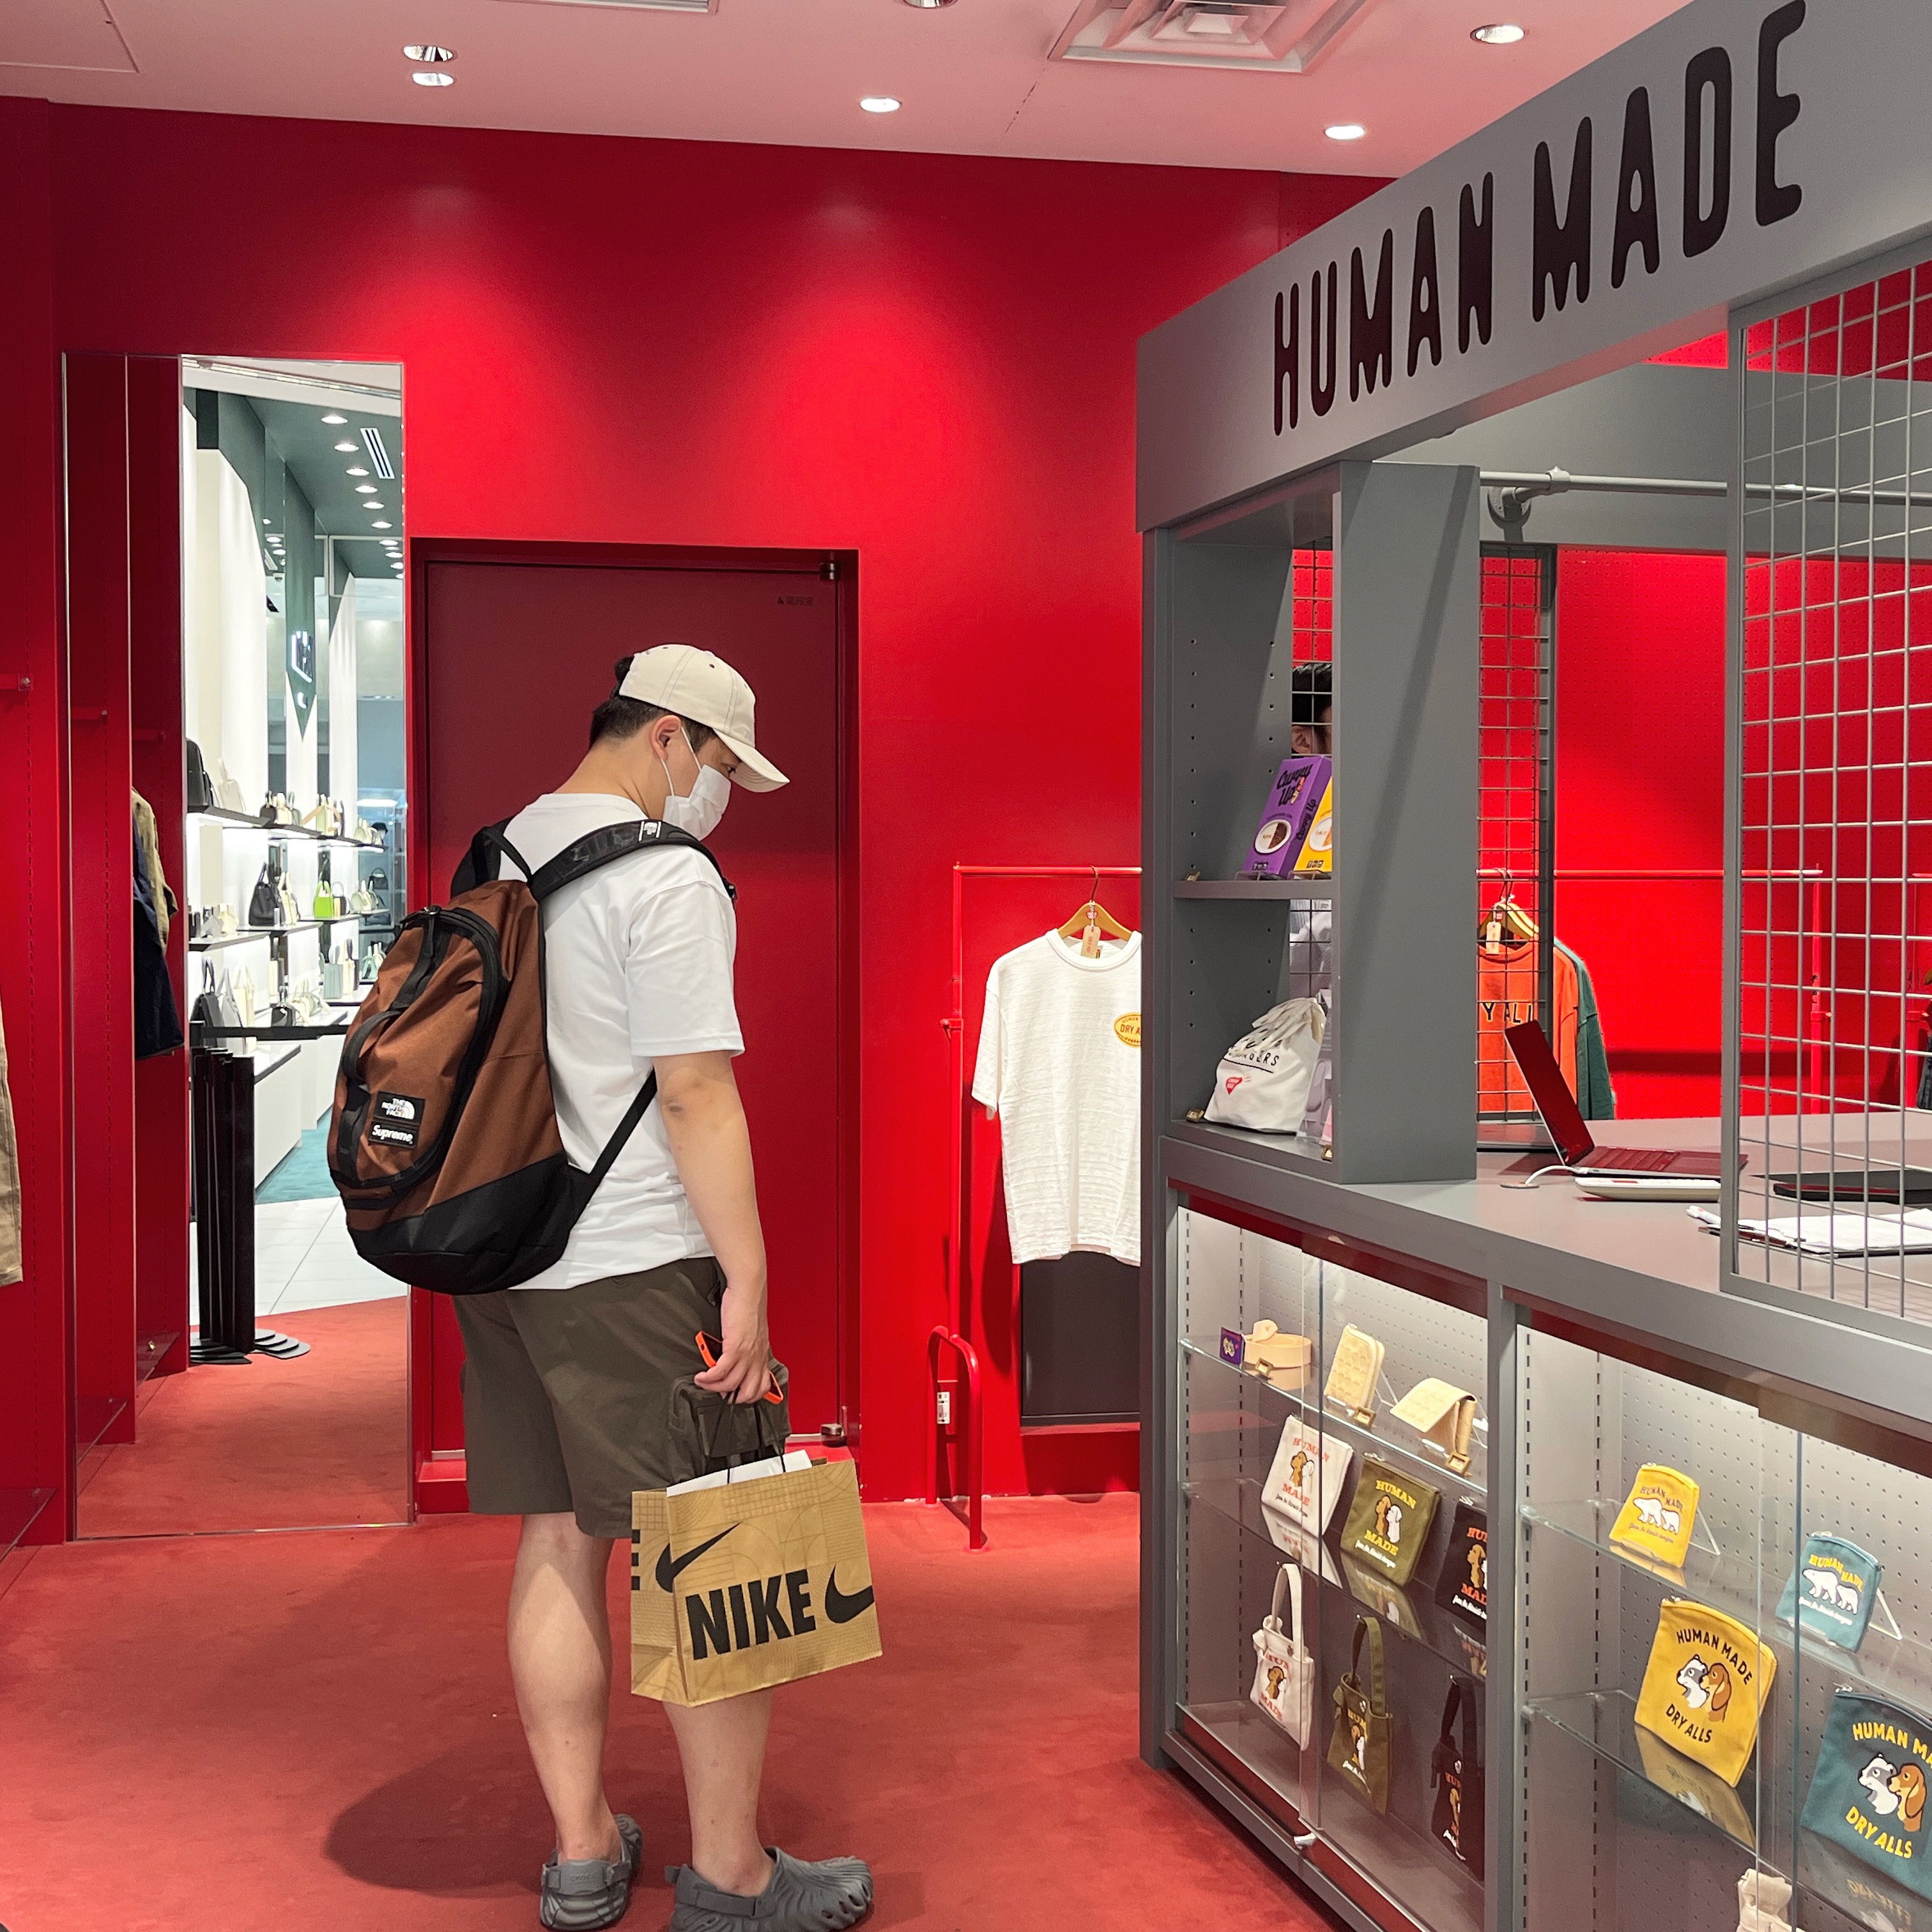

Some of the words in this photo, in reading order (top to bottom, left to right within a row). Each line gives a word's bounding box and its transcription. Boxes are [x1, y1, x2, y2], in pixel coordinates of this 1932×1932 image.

[1273, 171, 1494, 437] HUMAN
[1533, 0, 1807, 322] MADE
[1120, 1023, 1135, 1034] DRY
[371, 1124, 414, 1142] Supreme
[1376, 1480, 1417, 1510] HUMAN
[1364, 1529, 1399, 1556] MADE
[1808, 1554, 1844, 1574] HUMAN
[685, 1568, 816, 1661] NIKE
[1676, 1628, 1719, 1651] HUMAN
[1721, 1643, 1753, 1686] MADE
[1666, 1703, 1688, 1730] DRY
[1683, 1723, 1713, 1744] ALLS
[1853, 1721, 1909, 1749] HUMAN
[1845, 1805, 1879, 1840] DRY
[1873, 1832, 1913, 1859] ALLS
